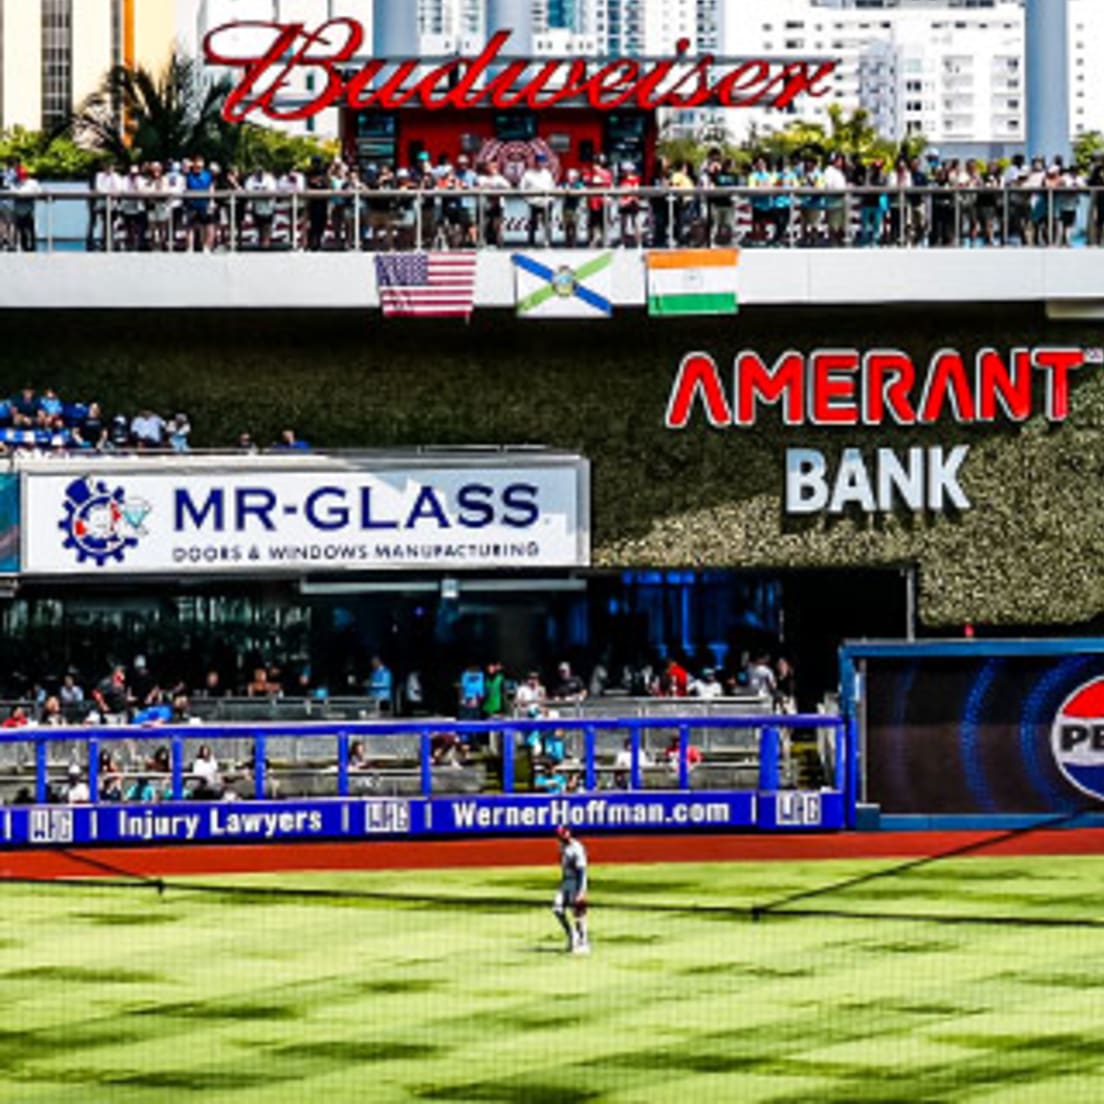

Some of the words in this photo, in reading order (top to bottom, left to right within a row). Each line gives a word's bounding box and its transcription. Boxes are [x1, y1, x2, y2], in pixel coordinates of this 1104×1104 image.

[201, 17, 838, 124] Budweiser
[665, 348, 1086, 428] AMERANT
[173, 483, 541, 532] MR-GLASS
[785, 445, 971, 513] BANK
[172, 547, 242, 563] DOORS
[269, 544, 367, 561] WINDOWS
[374, 541, 540, 559] MANUFACTURING
[118, 809, 200, 840] Injury
[210, 807, 323, 835] Lawyers
[452, 798, 730, 827] WernerHoffman.com
